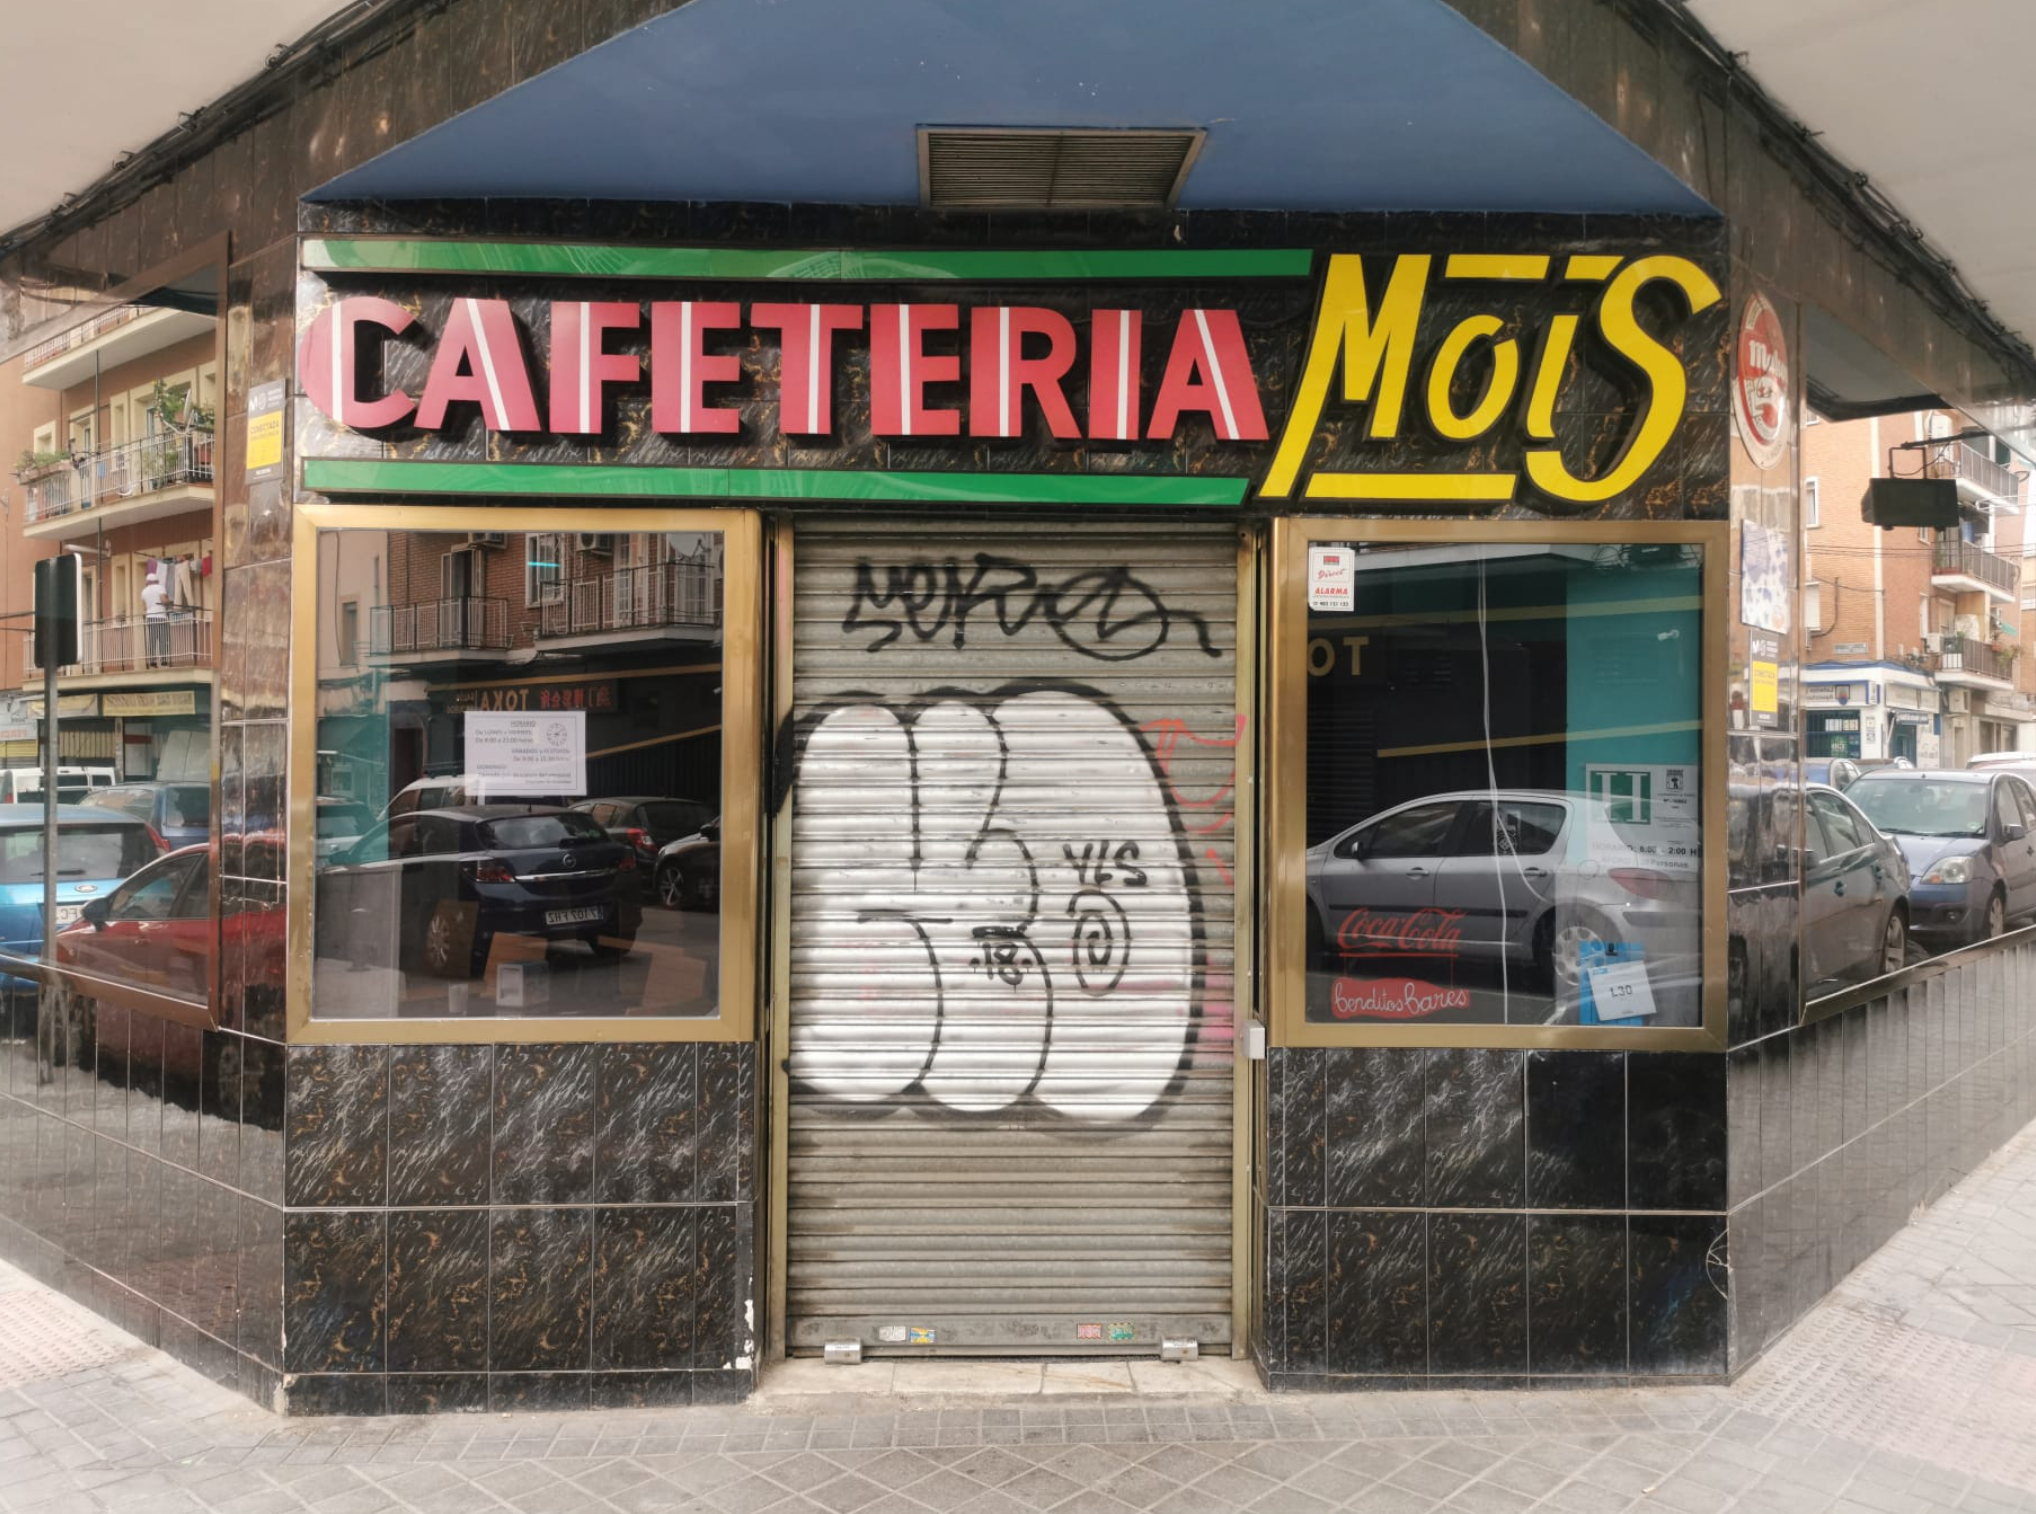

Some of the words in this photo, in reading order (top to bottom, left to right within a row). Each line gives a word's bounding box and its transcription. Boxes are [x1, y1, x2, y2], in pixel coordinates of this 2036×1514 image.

[297, 296, 1271, 440] CAFETERIA
[1315, 587, 1348, 595] ALARMA
[1594, 772, 1649, 823] H
[1668, 846, 1687, 855] 2:00
